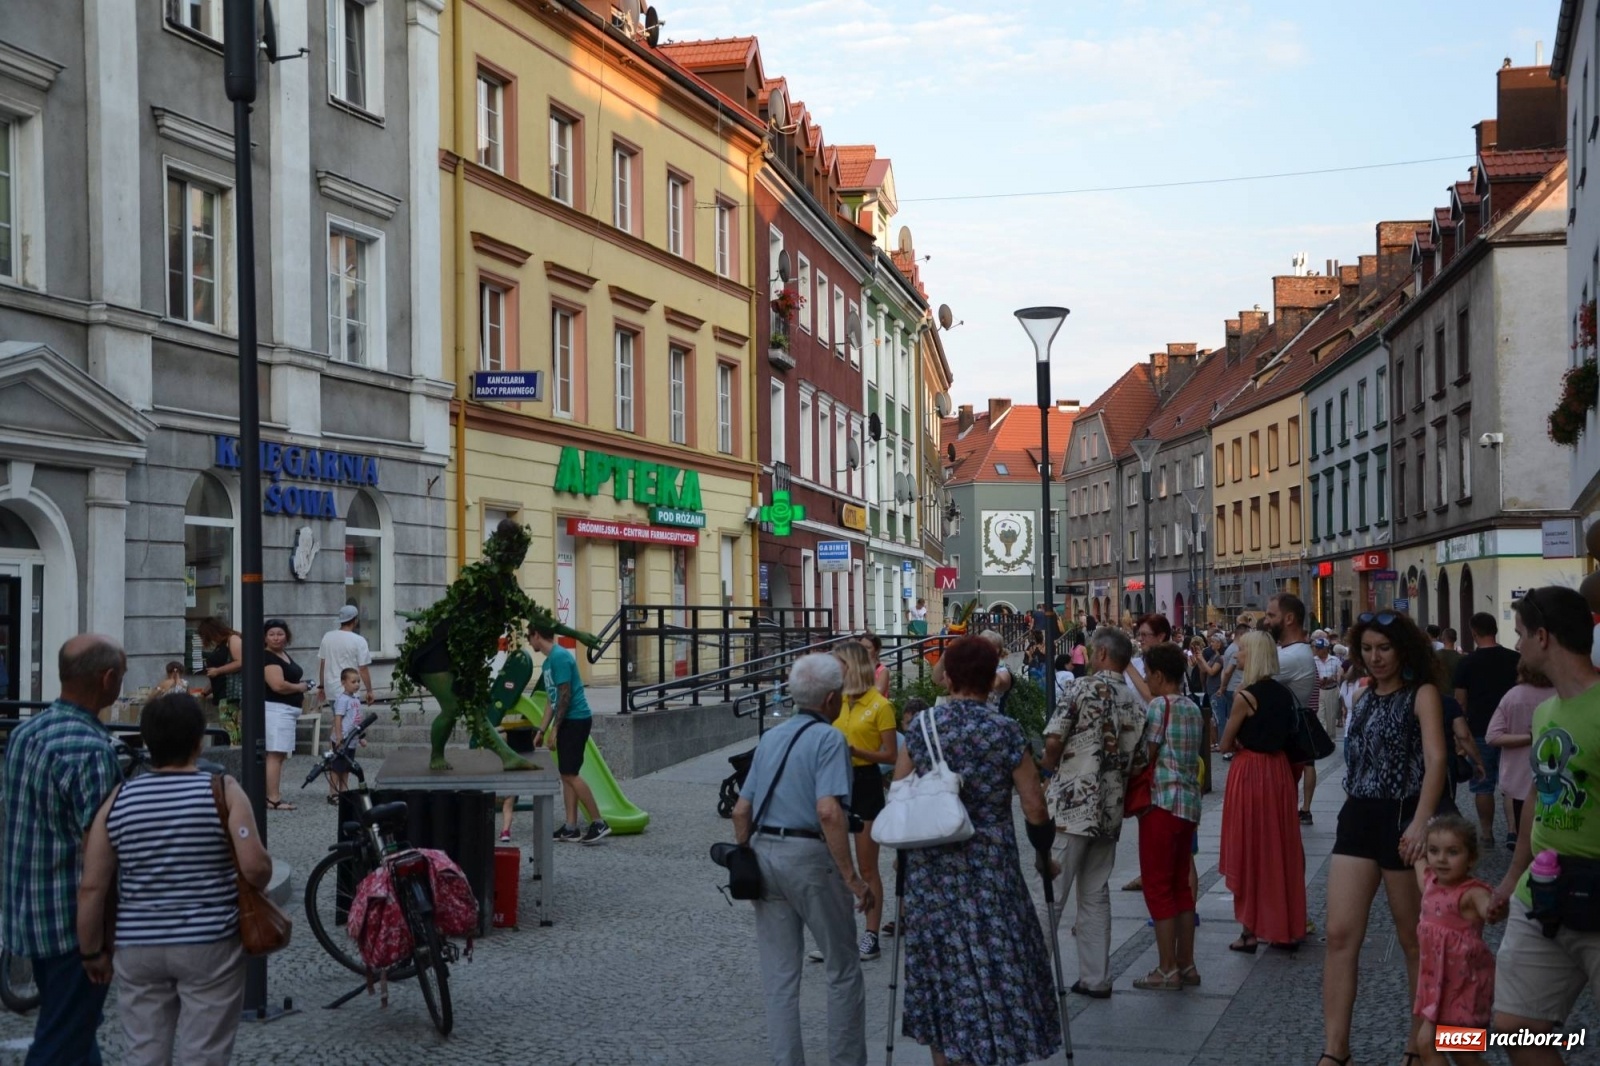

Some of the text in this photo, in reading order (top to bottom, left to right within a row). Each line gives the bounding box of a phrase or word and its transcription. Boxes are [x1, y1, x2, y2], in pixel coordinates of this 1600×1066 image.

[487, 374, 525, 385] KANCELARIA
[476, 386, 535, 397] RADCY PRAWNEGO
[214, 435, 379, 486] KIĘGARNIA
[553, 446, 703, 512] APTEKA
[264, 483, 337, 520] SOWA
[658, 510, 704, 526] POD RÓŻAMI
[577, 521, 619, 536] ŚRÓDMIEJSKA
[623, 528, 650, 538] CENTRUM
[650, 530, 696, 543] FARMACEUTYCZNE
[942, 575, 957, 590] M
